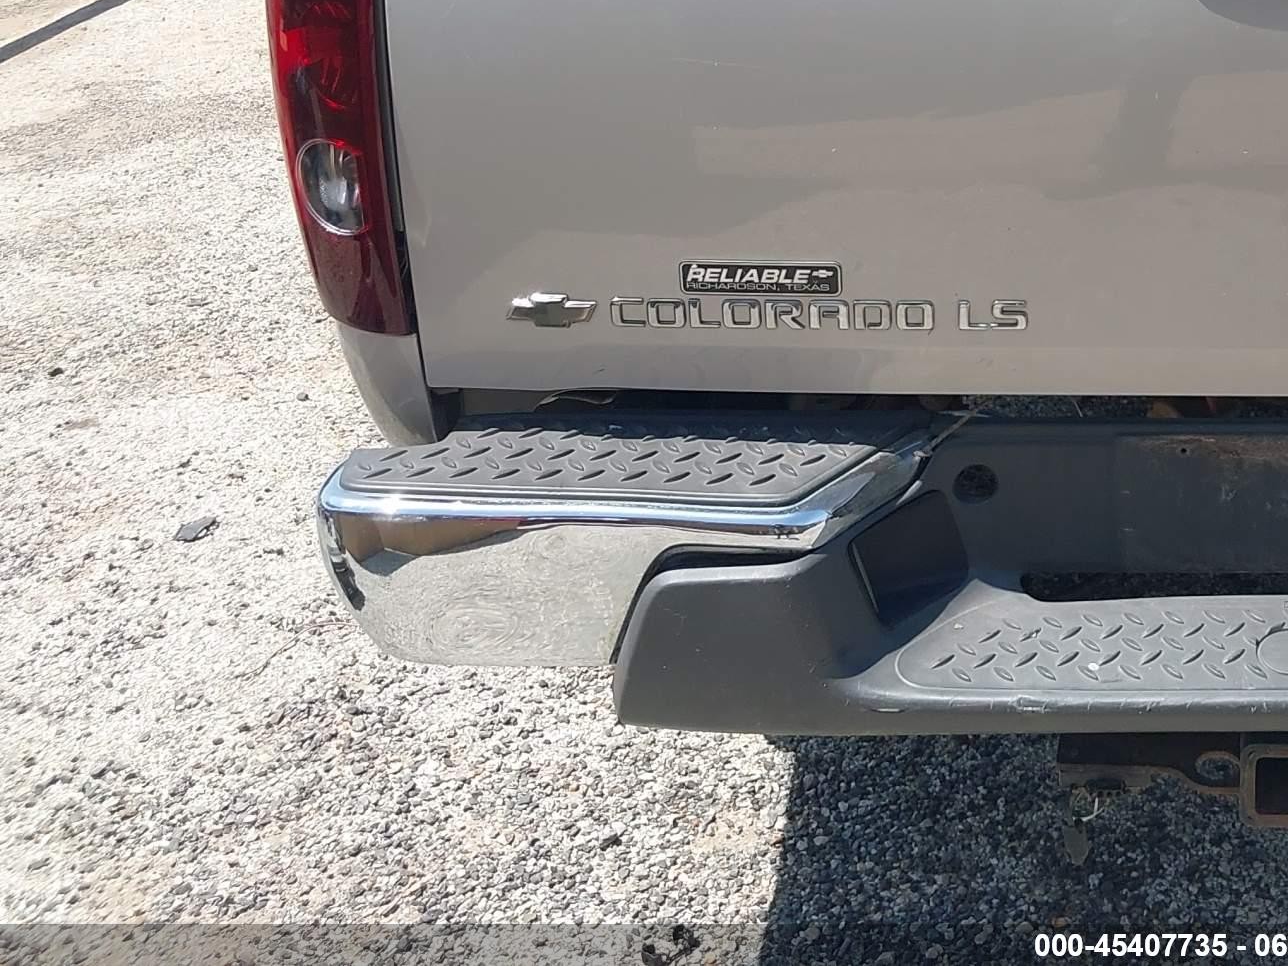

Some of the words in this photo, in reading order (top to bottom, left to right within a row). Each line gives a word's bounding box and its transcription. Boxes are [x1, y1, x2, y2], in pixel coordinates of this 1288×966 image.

[686, 265, 811, 284] RELIABLE
[686, 282, 780, 292] RICHARDSON,
[787, 283, 830, 292] TEXAS
[609, 297, 936, 331] COLORADO
[957, 299, 1029, 331] LS
